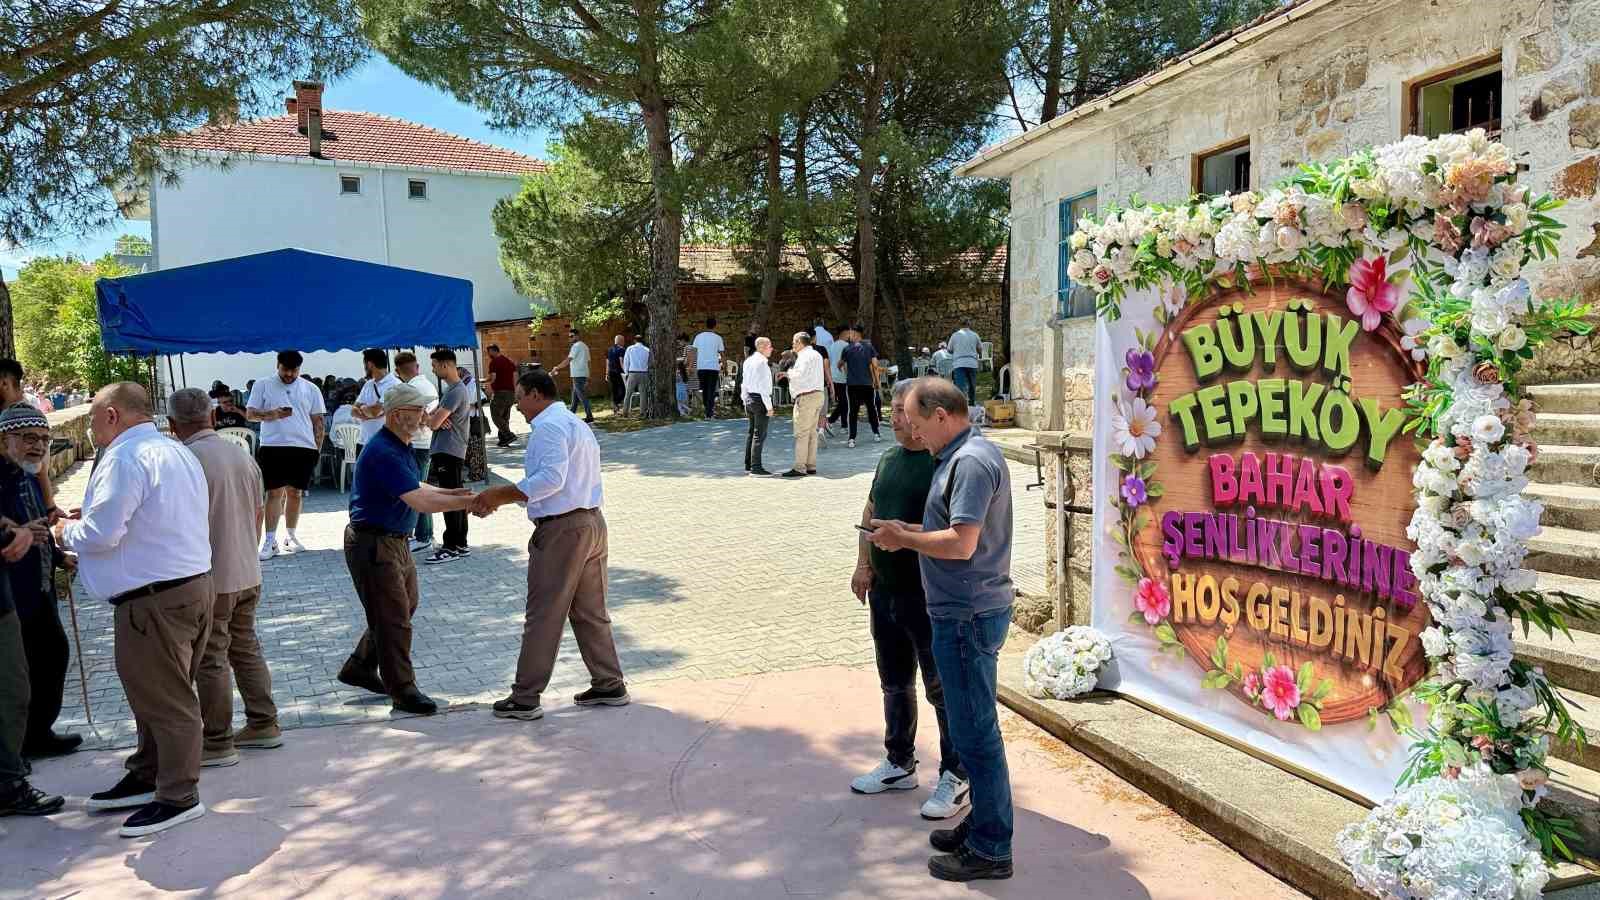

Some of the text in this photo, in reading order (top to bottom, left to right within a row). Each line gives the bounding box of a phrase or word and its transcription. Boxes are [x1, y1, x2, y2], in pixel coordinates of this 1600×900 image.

[1182, 300, 1358, 379] BÜYÜK
[1170, 374, 1405, 469] TEPEKÖY
[1209, 452, 1354, 522] BAHAR
[1163, 506, 1417, 610] ŞENLİKLERİNE
[1172, 573, 1412, 682] HOŞ GELDİNİZ
